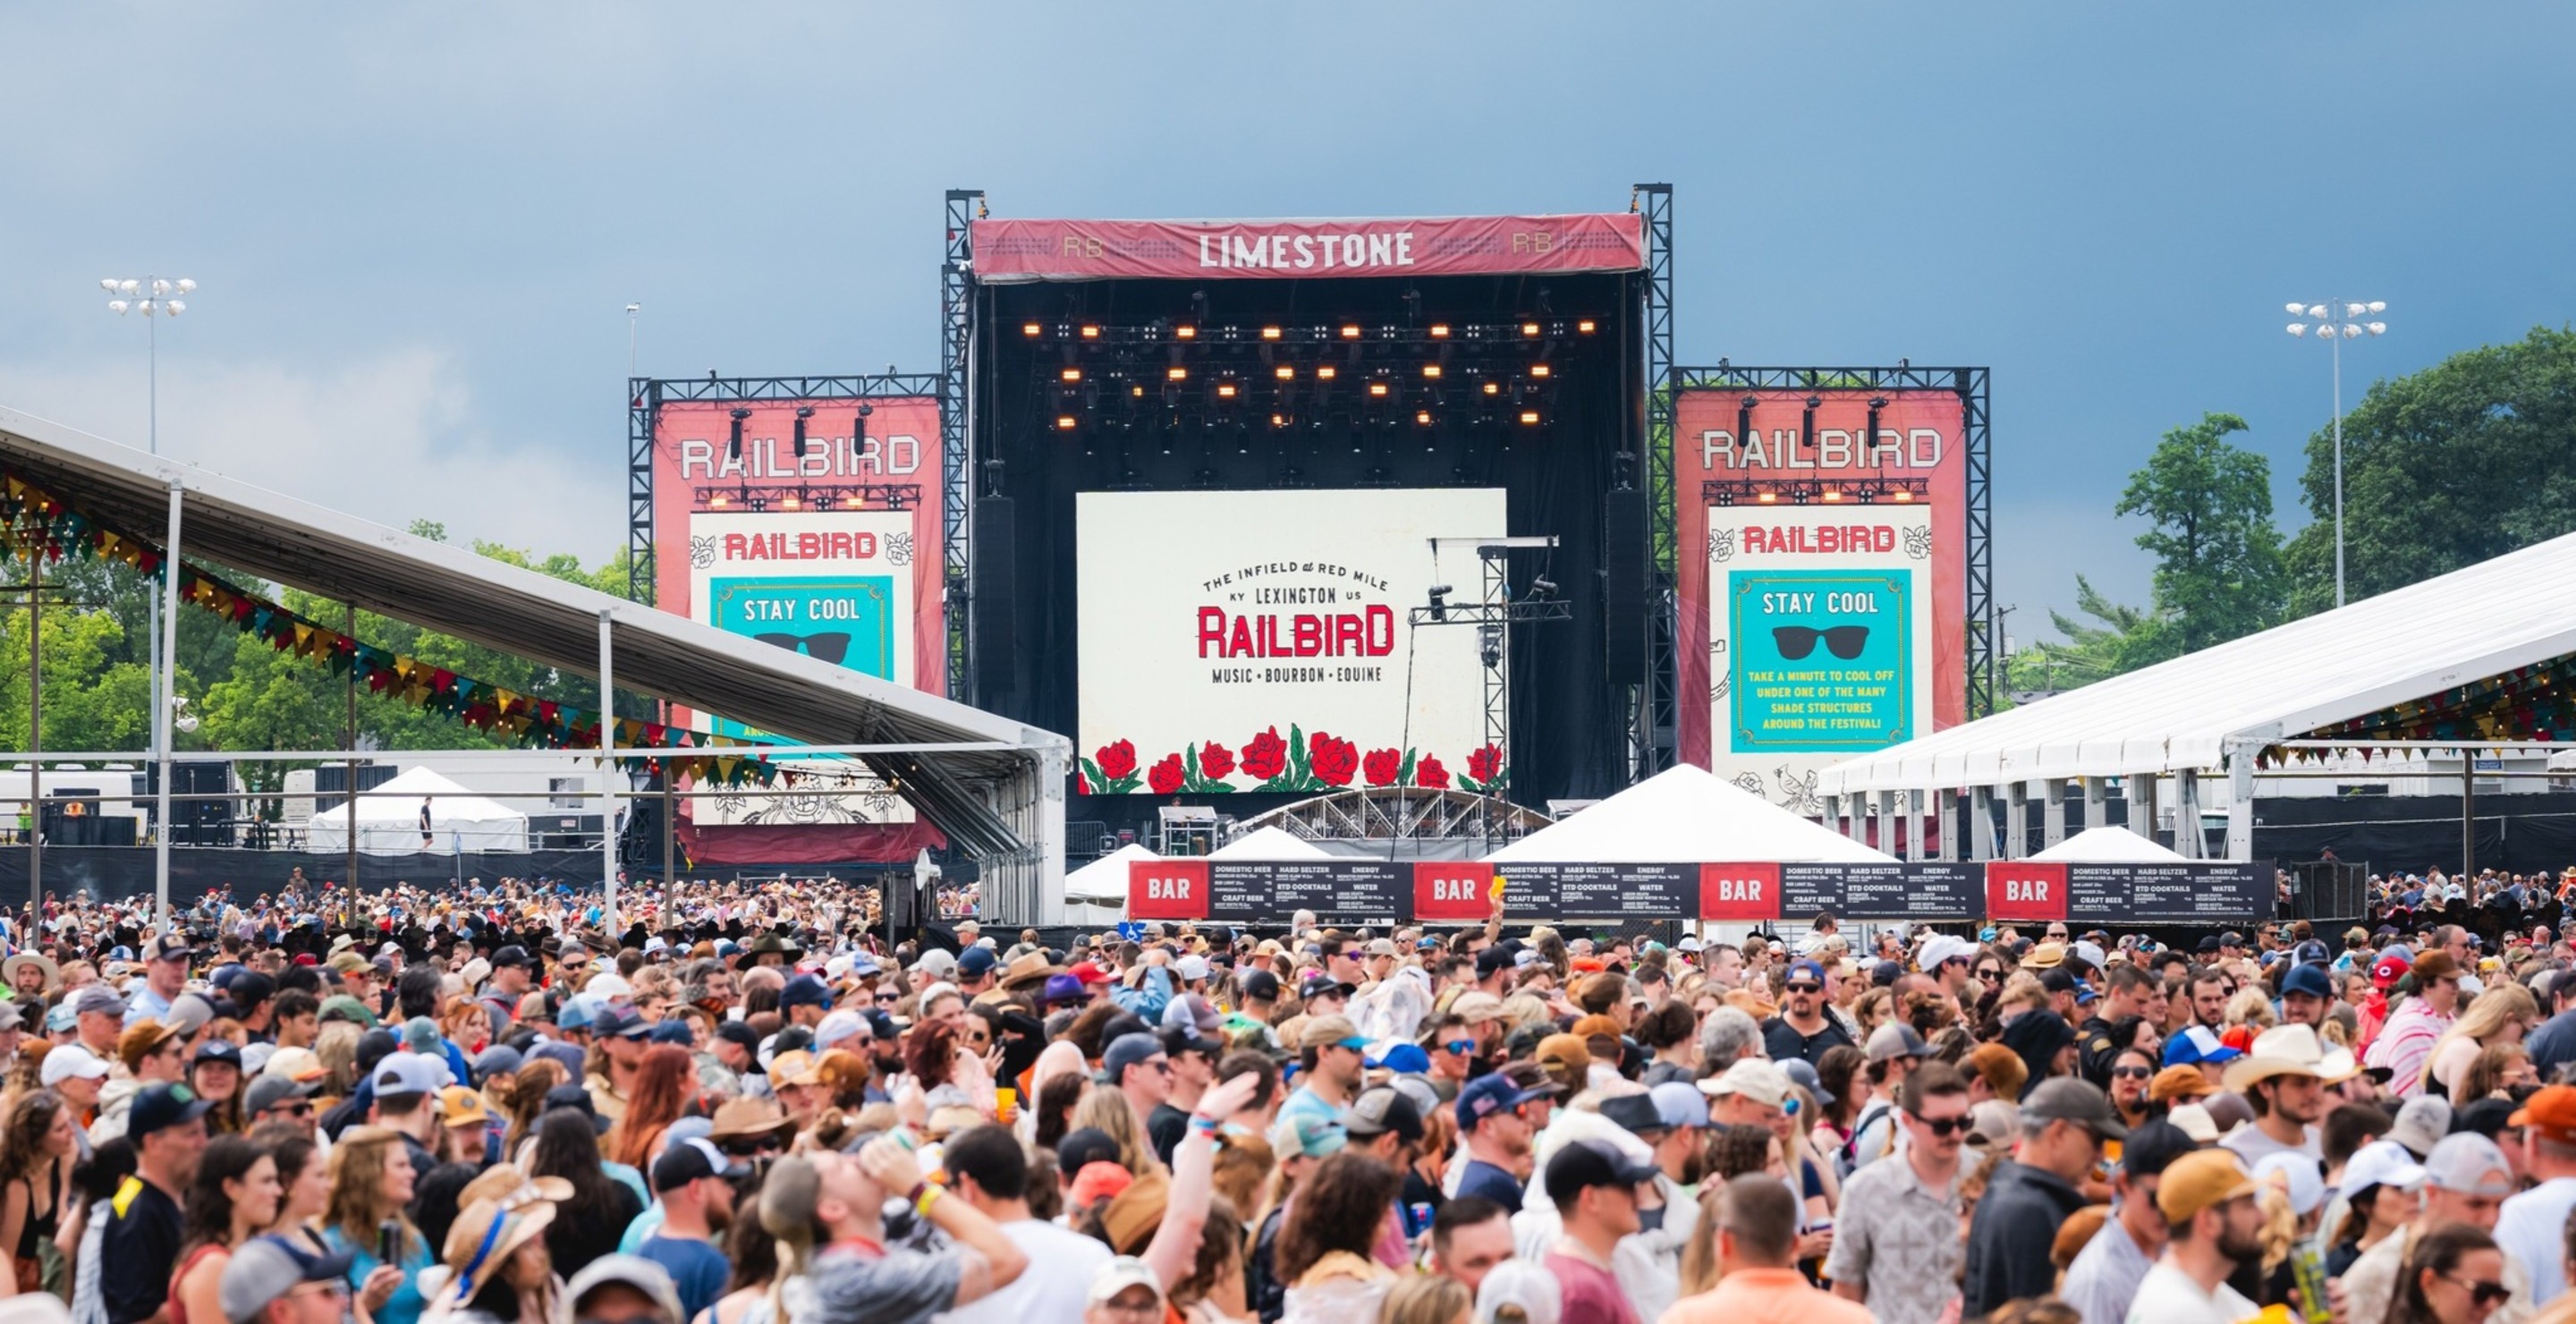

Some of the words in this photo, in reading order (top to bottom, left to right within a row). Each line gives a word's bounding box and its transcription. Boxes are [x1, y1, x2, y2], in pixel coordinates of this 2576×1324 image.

[1199, 231, 1414, 269] LIMESTONE
[681, 435, 920, 479] RAILBIRD
[1702, 429, 1942, 469] RAILBIRD
[725, 531, 877, 560] RAILBIRD
[1744, 525, 1895, 553] RAILBIRD
[1203, 573, 1232, 592] THE
[1238, 562, 1297, 580] INFIELD
[1318, 564, 1346, 577] RED
[1353, 571, 1388, 591] MILE
[1230, 593, 1245, 601] KY
[1256, 587, 1336, 604] LEXINGTON
[1346, 591, 1361, 600] US
[1763, 592, 1815, 614] STAY
[1827, 592, 1878, 613] COOL
[744, 599, 796, 621] STAY
[809, 598, 860, 620] COOL
[1198, 604, 1394, 658] RAILBIRD
[1212, 668, 1252, 683] MUSIC
[1266, 667, 1324, 683] BOURBON
[1337, 666, 1382, 682] EQUINE
[1749, 672, 1775, 682] TAKE
[1777, 672, 1784, 682] A
[1787, 671, 1826, 682] MINUTE
[1829, 671, 1843, 681] TO
[1845, 671, 1871, 681] COOL
[1875, 671, 1894, 681] OFF
[1757, 687, 1791, 698] UNDER
[1794, 687, 1815, 697] ONE
[1818, 687, 1831, 697] OF
[1835, 687, 1853, 697] THE
[1857, 687, 1886, 697] MANY
[1771, 703, 1804, 714] SHADE
[1808, 702, 1872, 713] STRUCTURES
[1763, 719, 1805, 729] AROUND
[1808, 718, 1827, 729] THE
[1831, 718, 1881, 728] FESTIVAL!
[1148, 878, 1190, 898] BAR
[1434, 879, 1475, 899] BAR
[1720, 880, 1761, 900] BAR
[2007, 881, 2048, 901] BAR
